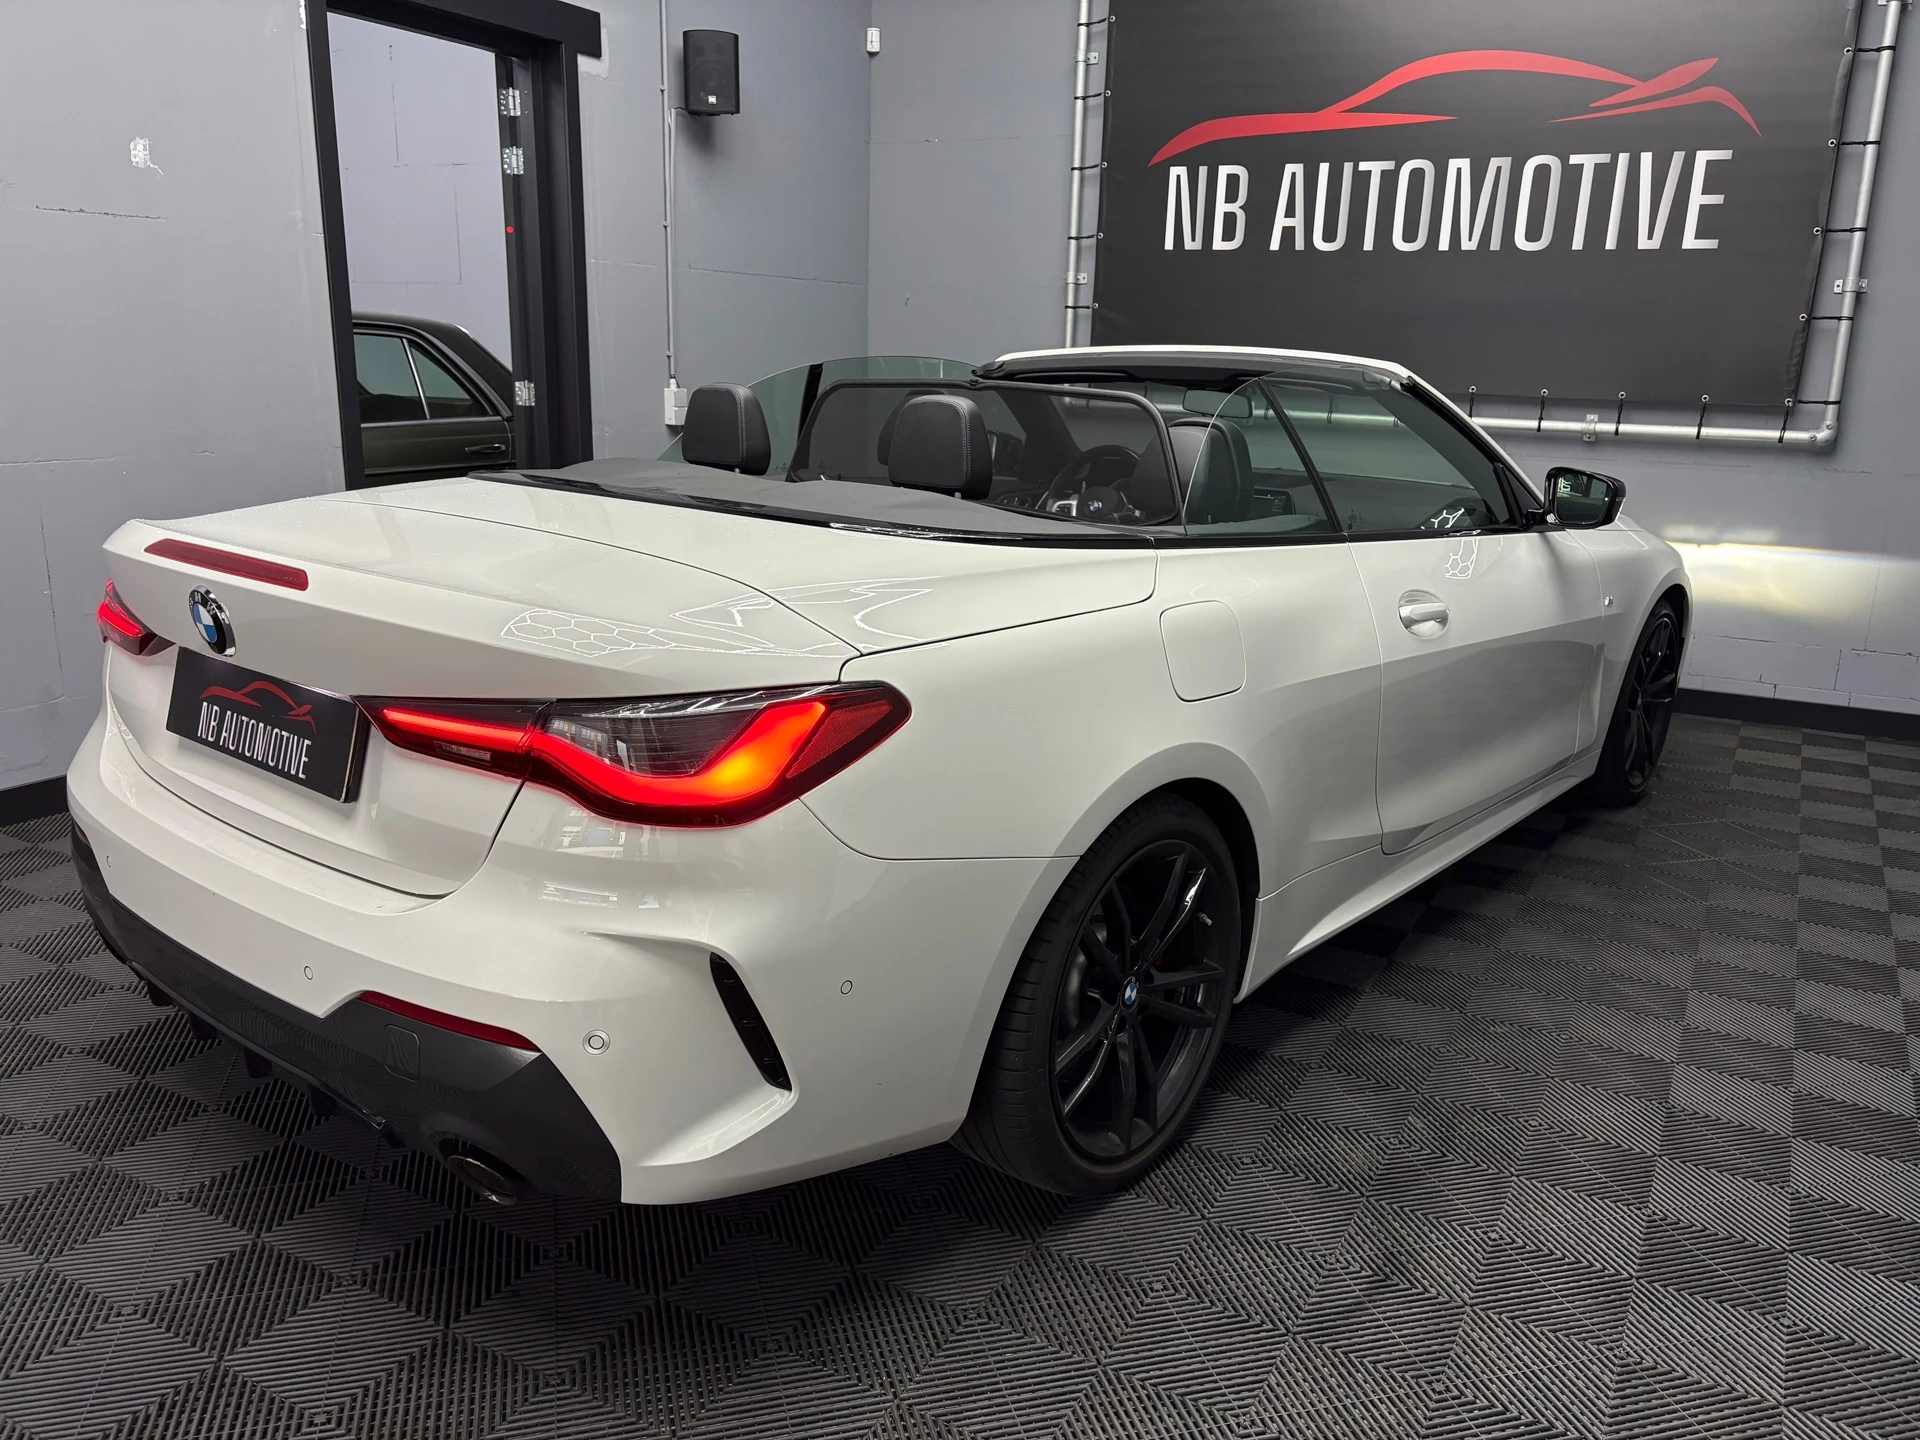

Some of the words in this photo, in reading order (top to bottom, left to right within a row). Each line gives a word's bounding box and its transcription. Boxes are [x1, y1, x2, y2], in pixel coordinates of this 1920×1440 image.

[1163, 164, 1249, 252] NB
[1269, 149, 1734, 252] AUTOMOTIVE
[197, 701, 219, 742] NB
[219, 710, 312, 780] AUTOMOTIVE
